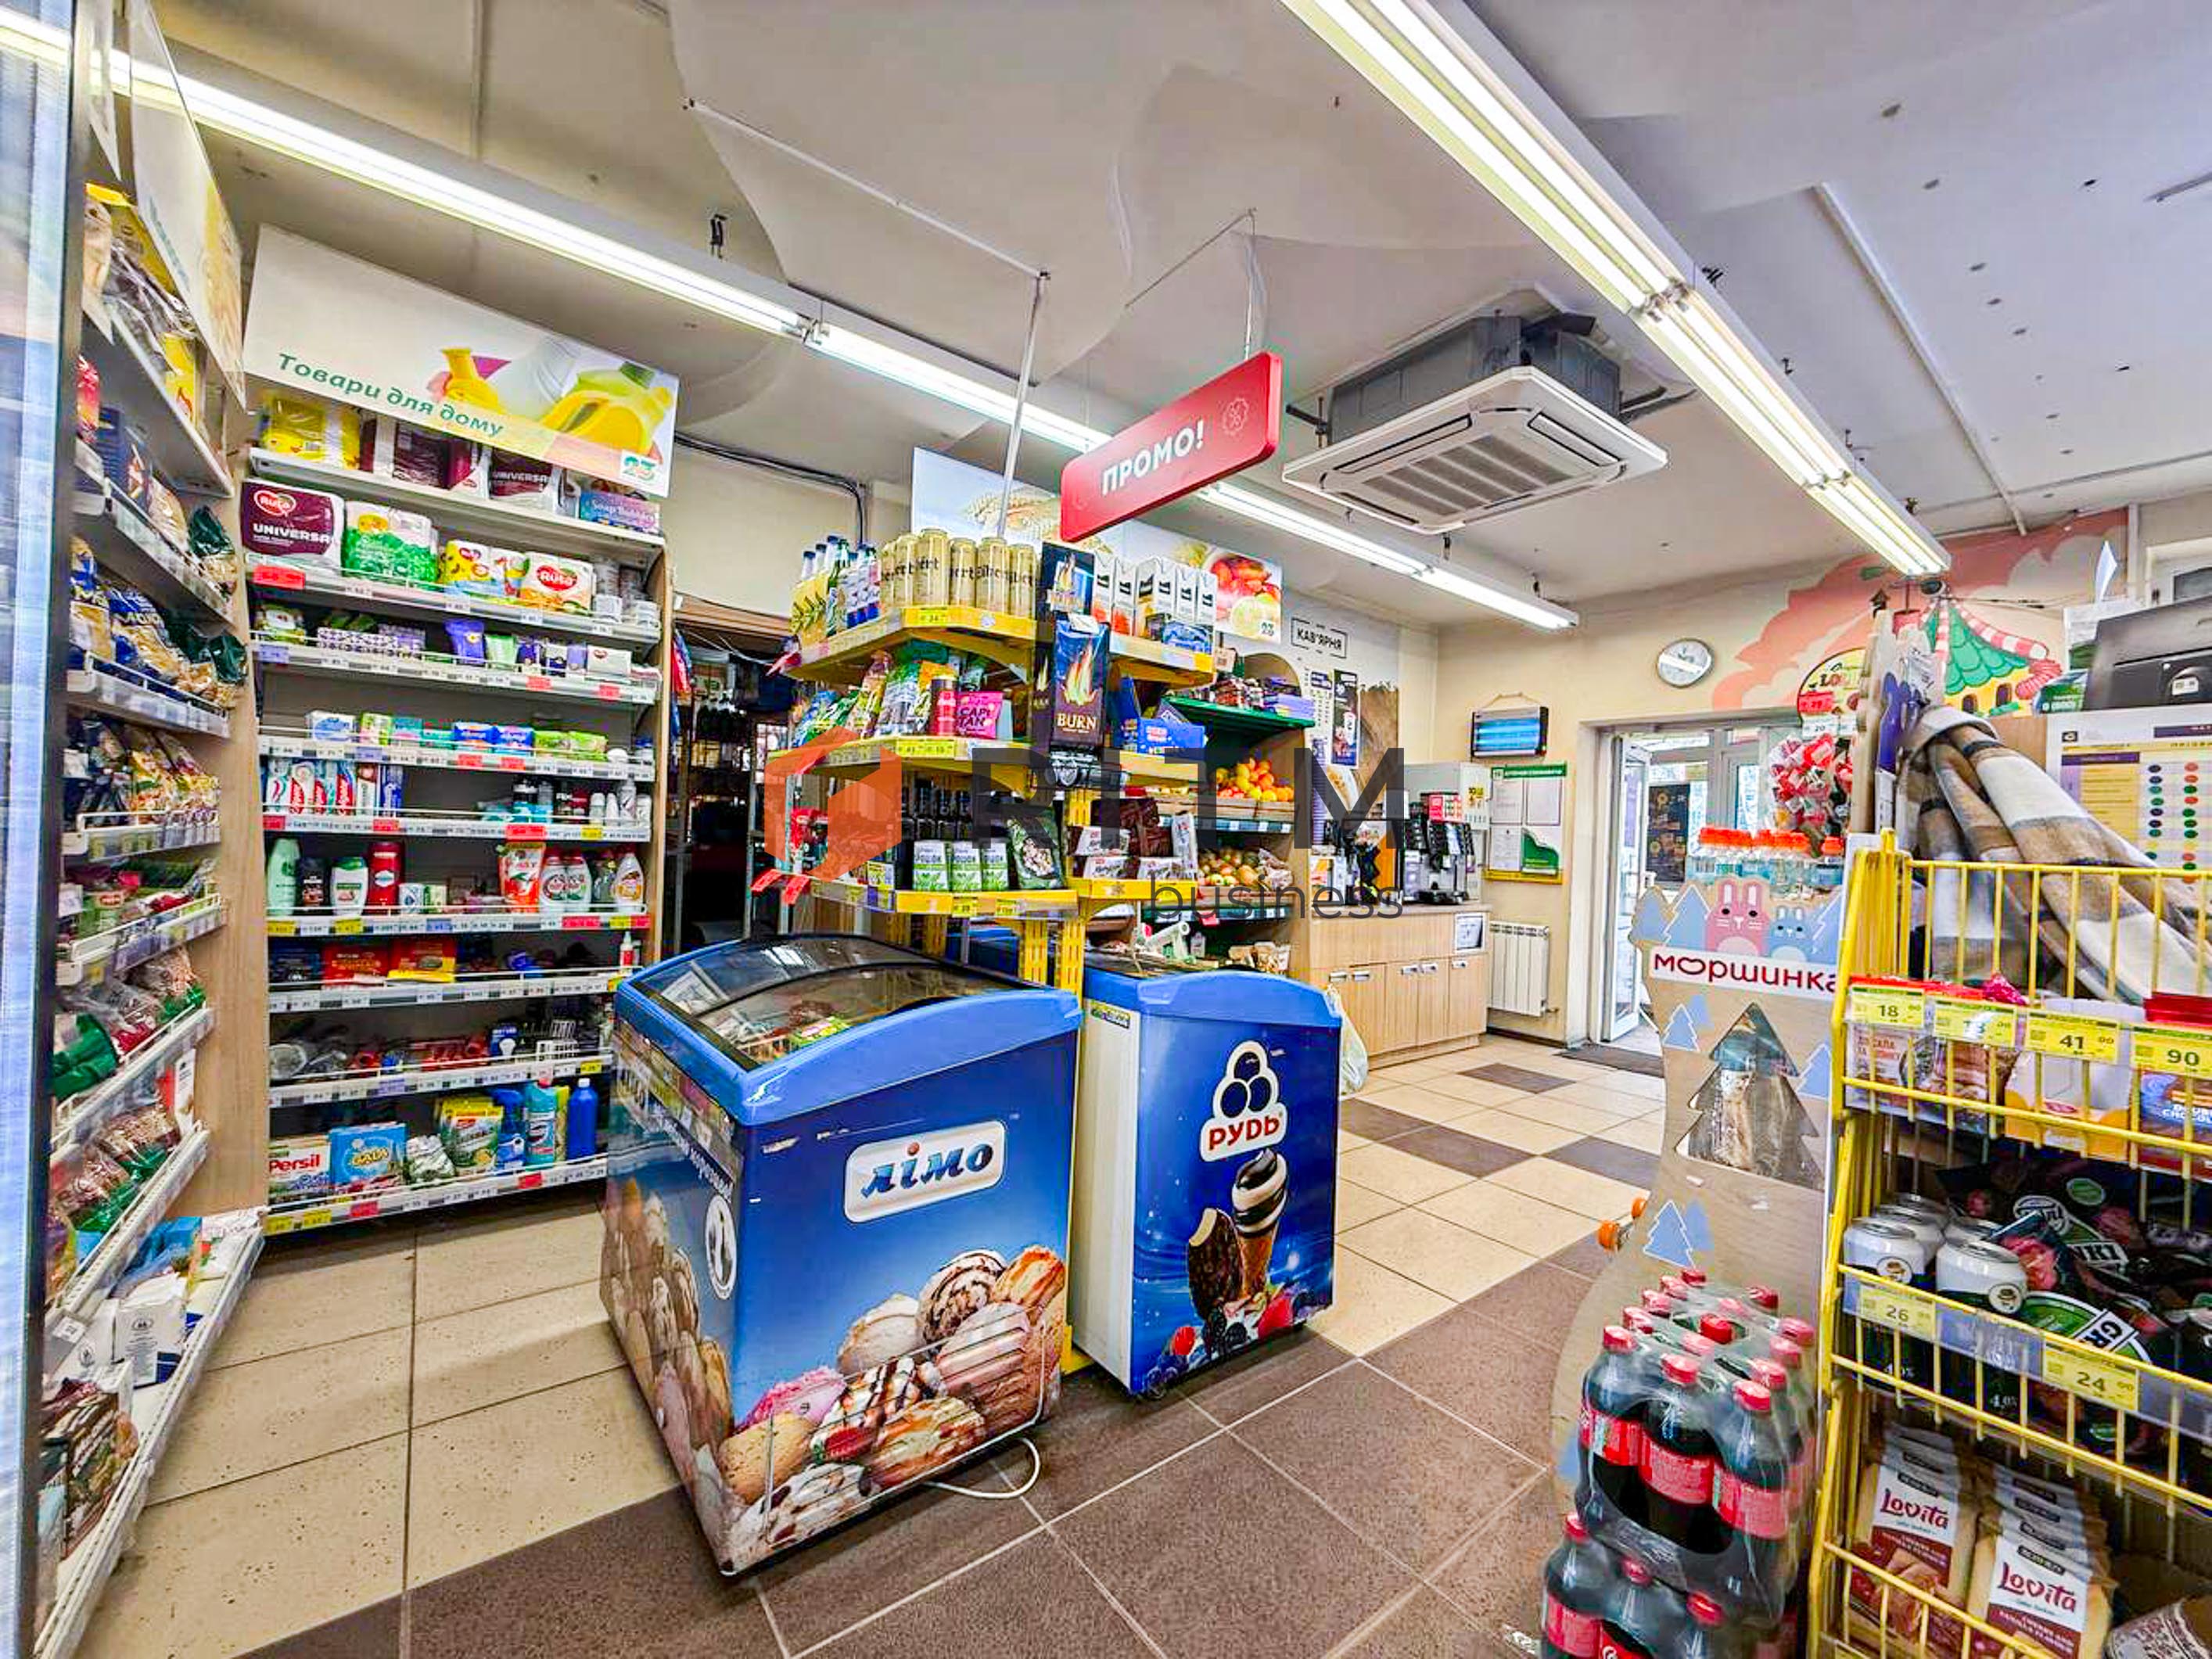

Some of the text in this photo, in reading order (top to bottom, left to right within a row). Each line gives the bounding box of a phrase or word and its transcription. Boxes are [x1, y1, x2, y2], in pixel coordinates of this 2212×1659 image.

[278, 353, 506, 437] Товари для дому
[1101, 419, 1205, 496] ПРОМО!
[1297, 627, 1342, 651] КАВ'ЯРНЯ
[1057, 713, 1097, 730] BURN
[1880, 1004, 1899, 1017] 18
[2059, 1034, 2084, 1050] 41
[2167, 1049, 2200, 1067] 90
[1207, 1115, 1281, 1151] РУДЬ
[269, 1154, 321, 1173] Persil
[860, 1142, 994, 1198] лімо
[1886, 1304, 1909, 1323] 26
[2076, 1371, 2106, 1392] 24
[1880, 1488, 1949, 1530] Lovita
[1998, 1561, 2077, 1614] Lovita
